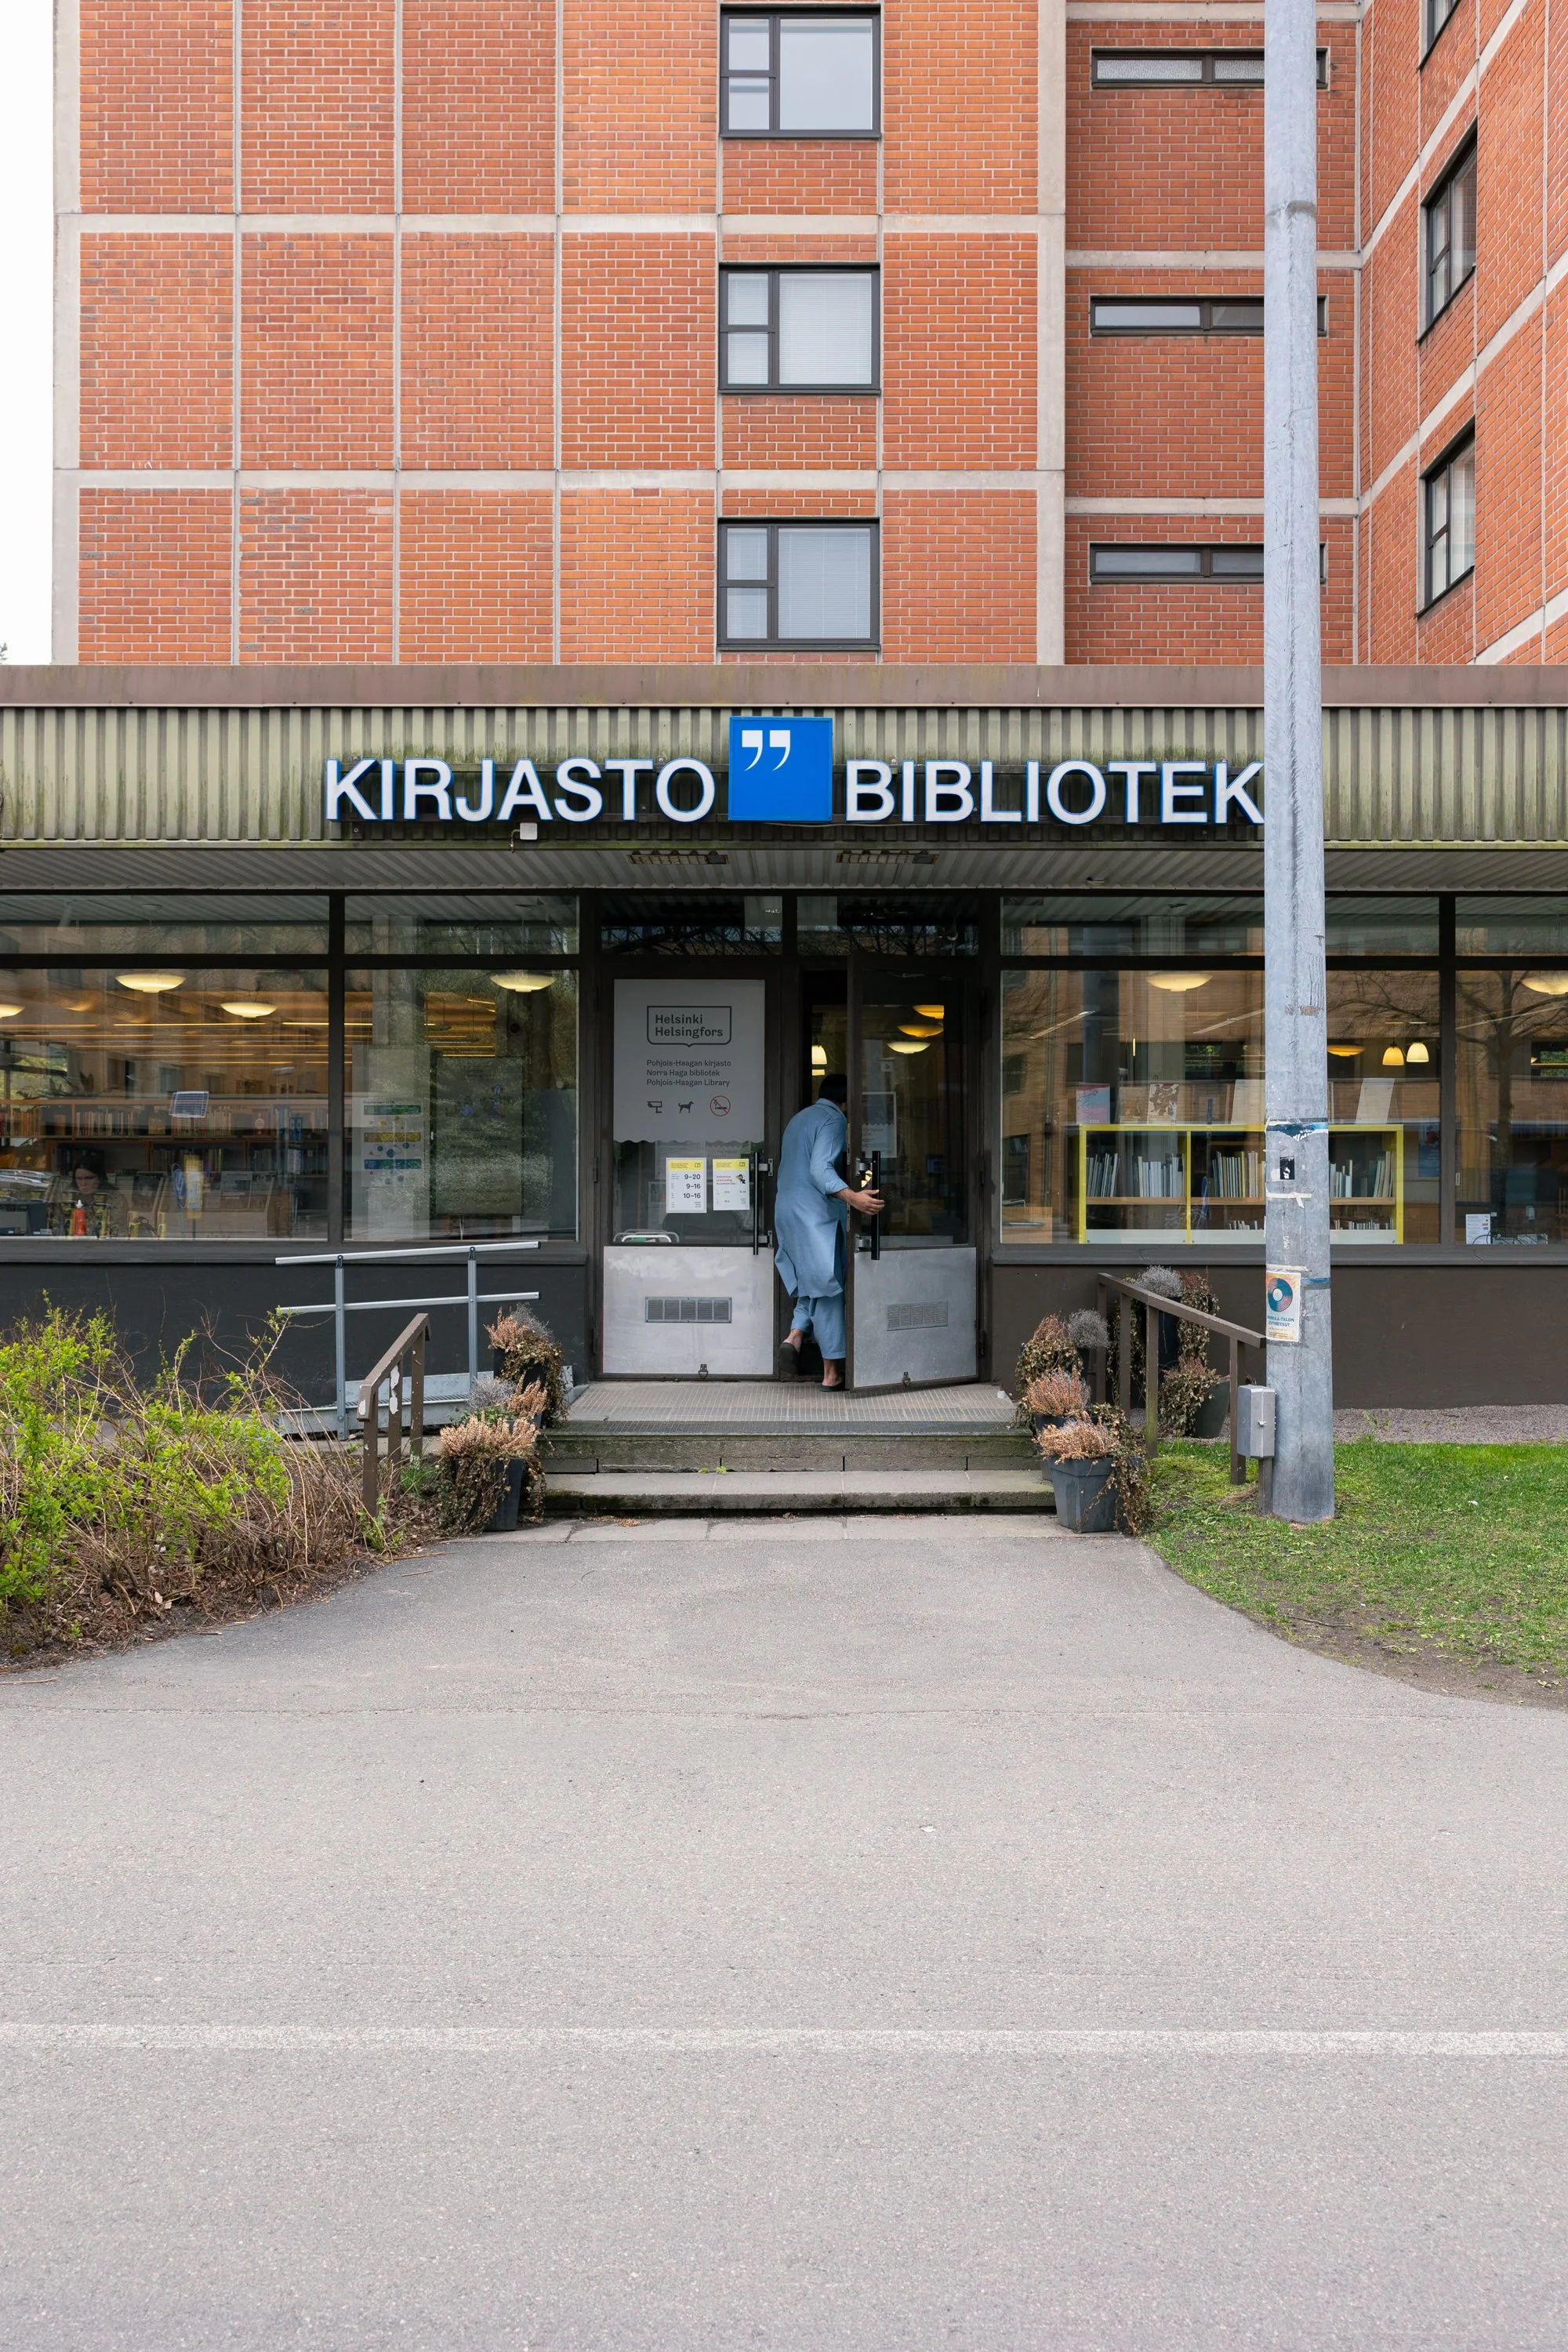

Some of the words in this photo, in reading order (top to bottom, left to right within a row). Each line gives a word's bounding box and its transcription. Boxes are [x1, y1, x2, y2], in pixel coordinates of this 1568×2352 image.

[325, 757, 715, 822] KIRJASTO
[844, 759, 1265, 825] BIBLIOTEK
[655, 1014, 703, 1024] Helsinki
[655, 1026, 724, 1039] Helsingfors
[704, 1059, 731, 1068] kirjasto
[669, 1069, 688, 1078] Haga
[646, 1079, 703, 1087] Pohjois-Haagan
[704, 1079, 731, 1087] Library
